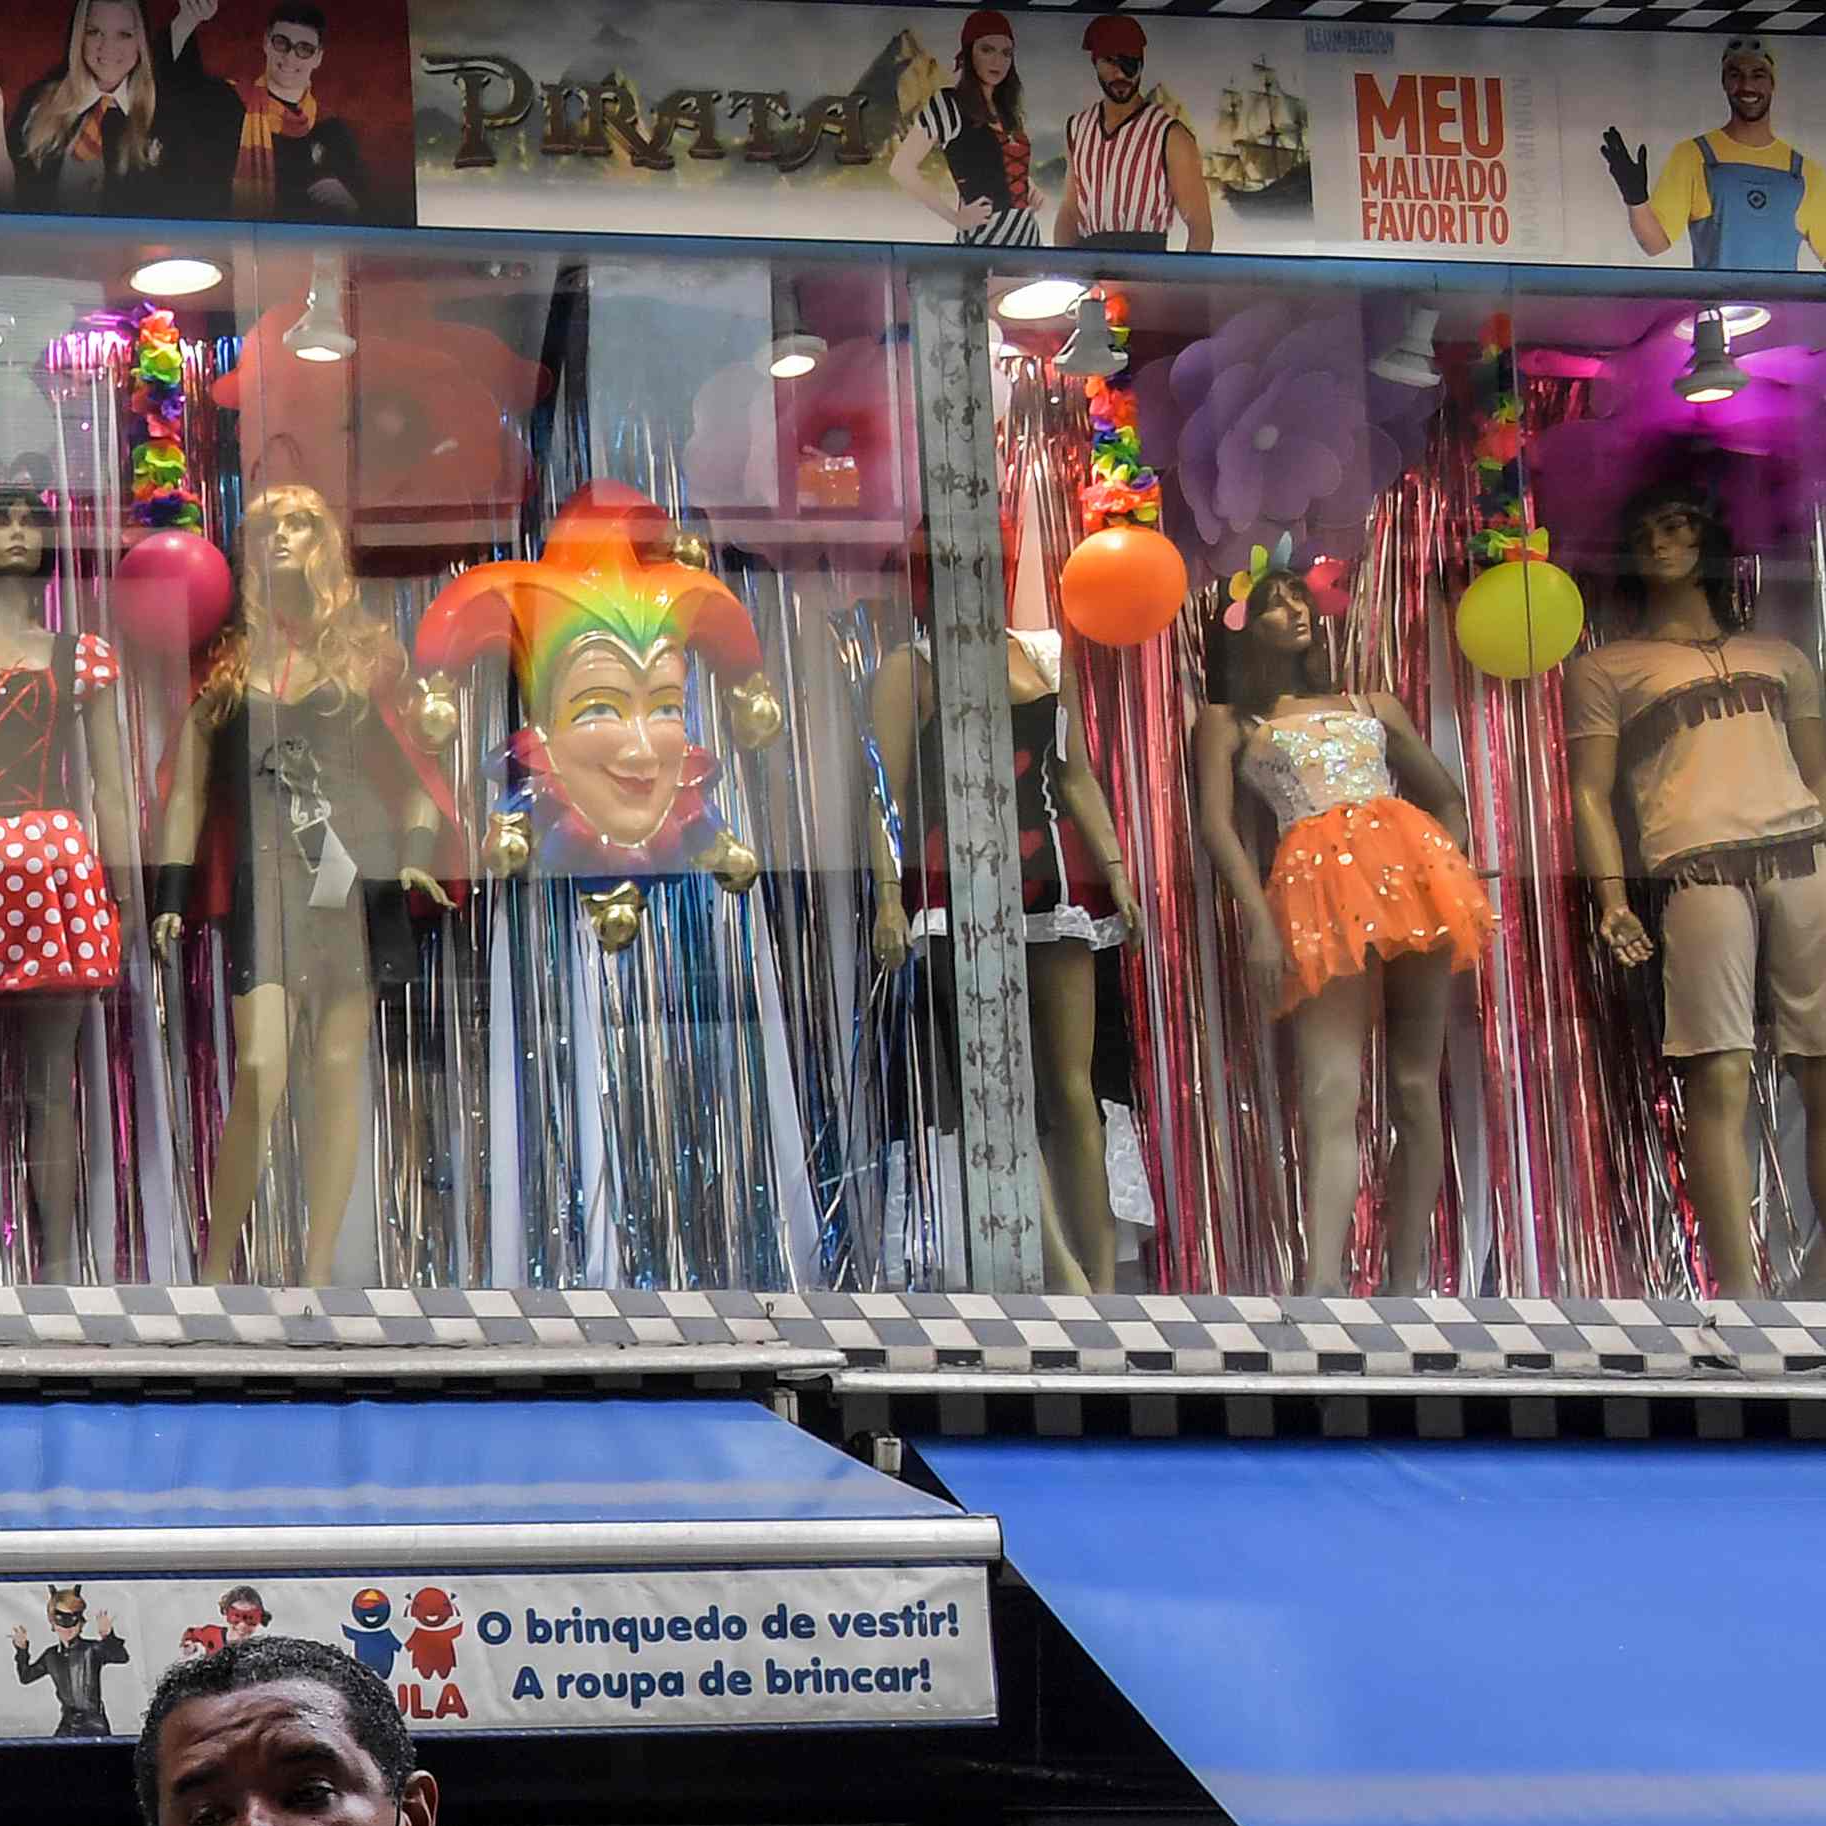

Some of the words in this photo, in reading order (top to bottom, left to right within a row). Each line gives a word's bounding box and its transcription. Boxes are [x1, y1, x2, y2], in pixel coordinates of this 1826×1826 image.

[420, 54, 873, 170] PIRATA
[1355, 72, 1504, 159] MEU
[1360, 156, 1507, 204] MALVADO
[1362, 200, 1509, 245] FAVORITO
[477, 1610, 512, 1645] O
[526, 1606, 747, 1653] brinquedo
[761, 1603, 816, 1640] de
[827, 1601, 959, 1638] vestir!
[397, 1683, 469, 1719] LA
[512, 1666, 544, 1700] A
[557, 1665, 684, 1708] roupa
[698, 1660, 753, 1696] de
[764, 1656, 933, 1695] brincar!
